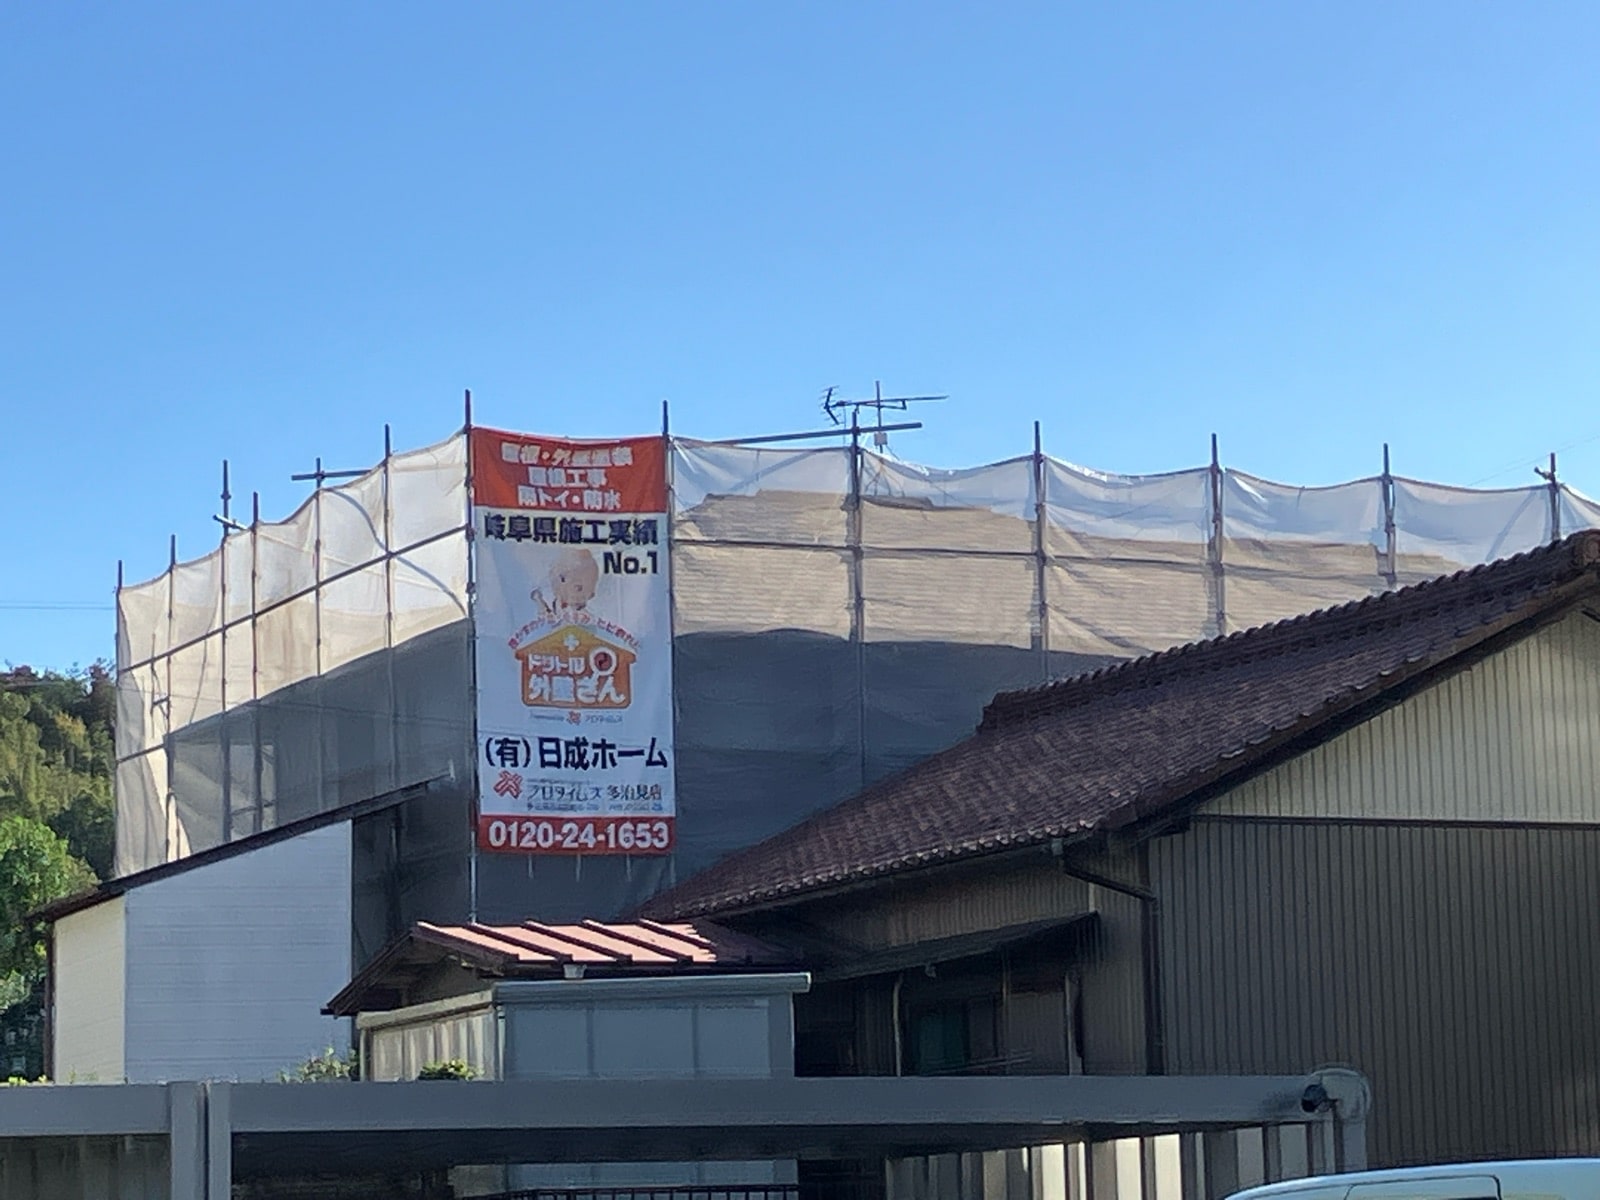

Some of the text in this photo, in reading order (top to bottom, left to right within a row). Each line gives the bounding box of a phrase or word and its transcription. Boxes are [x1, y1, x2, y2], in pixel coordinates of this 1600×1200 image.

[484, 512, 658, 545] 岐阜県施工実績
[604, 551, 658, 574] No.1
[529, 674, 626, 703] 外さん
[488, 820, 669, 849] 0120-24-1653
